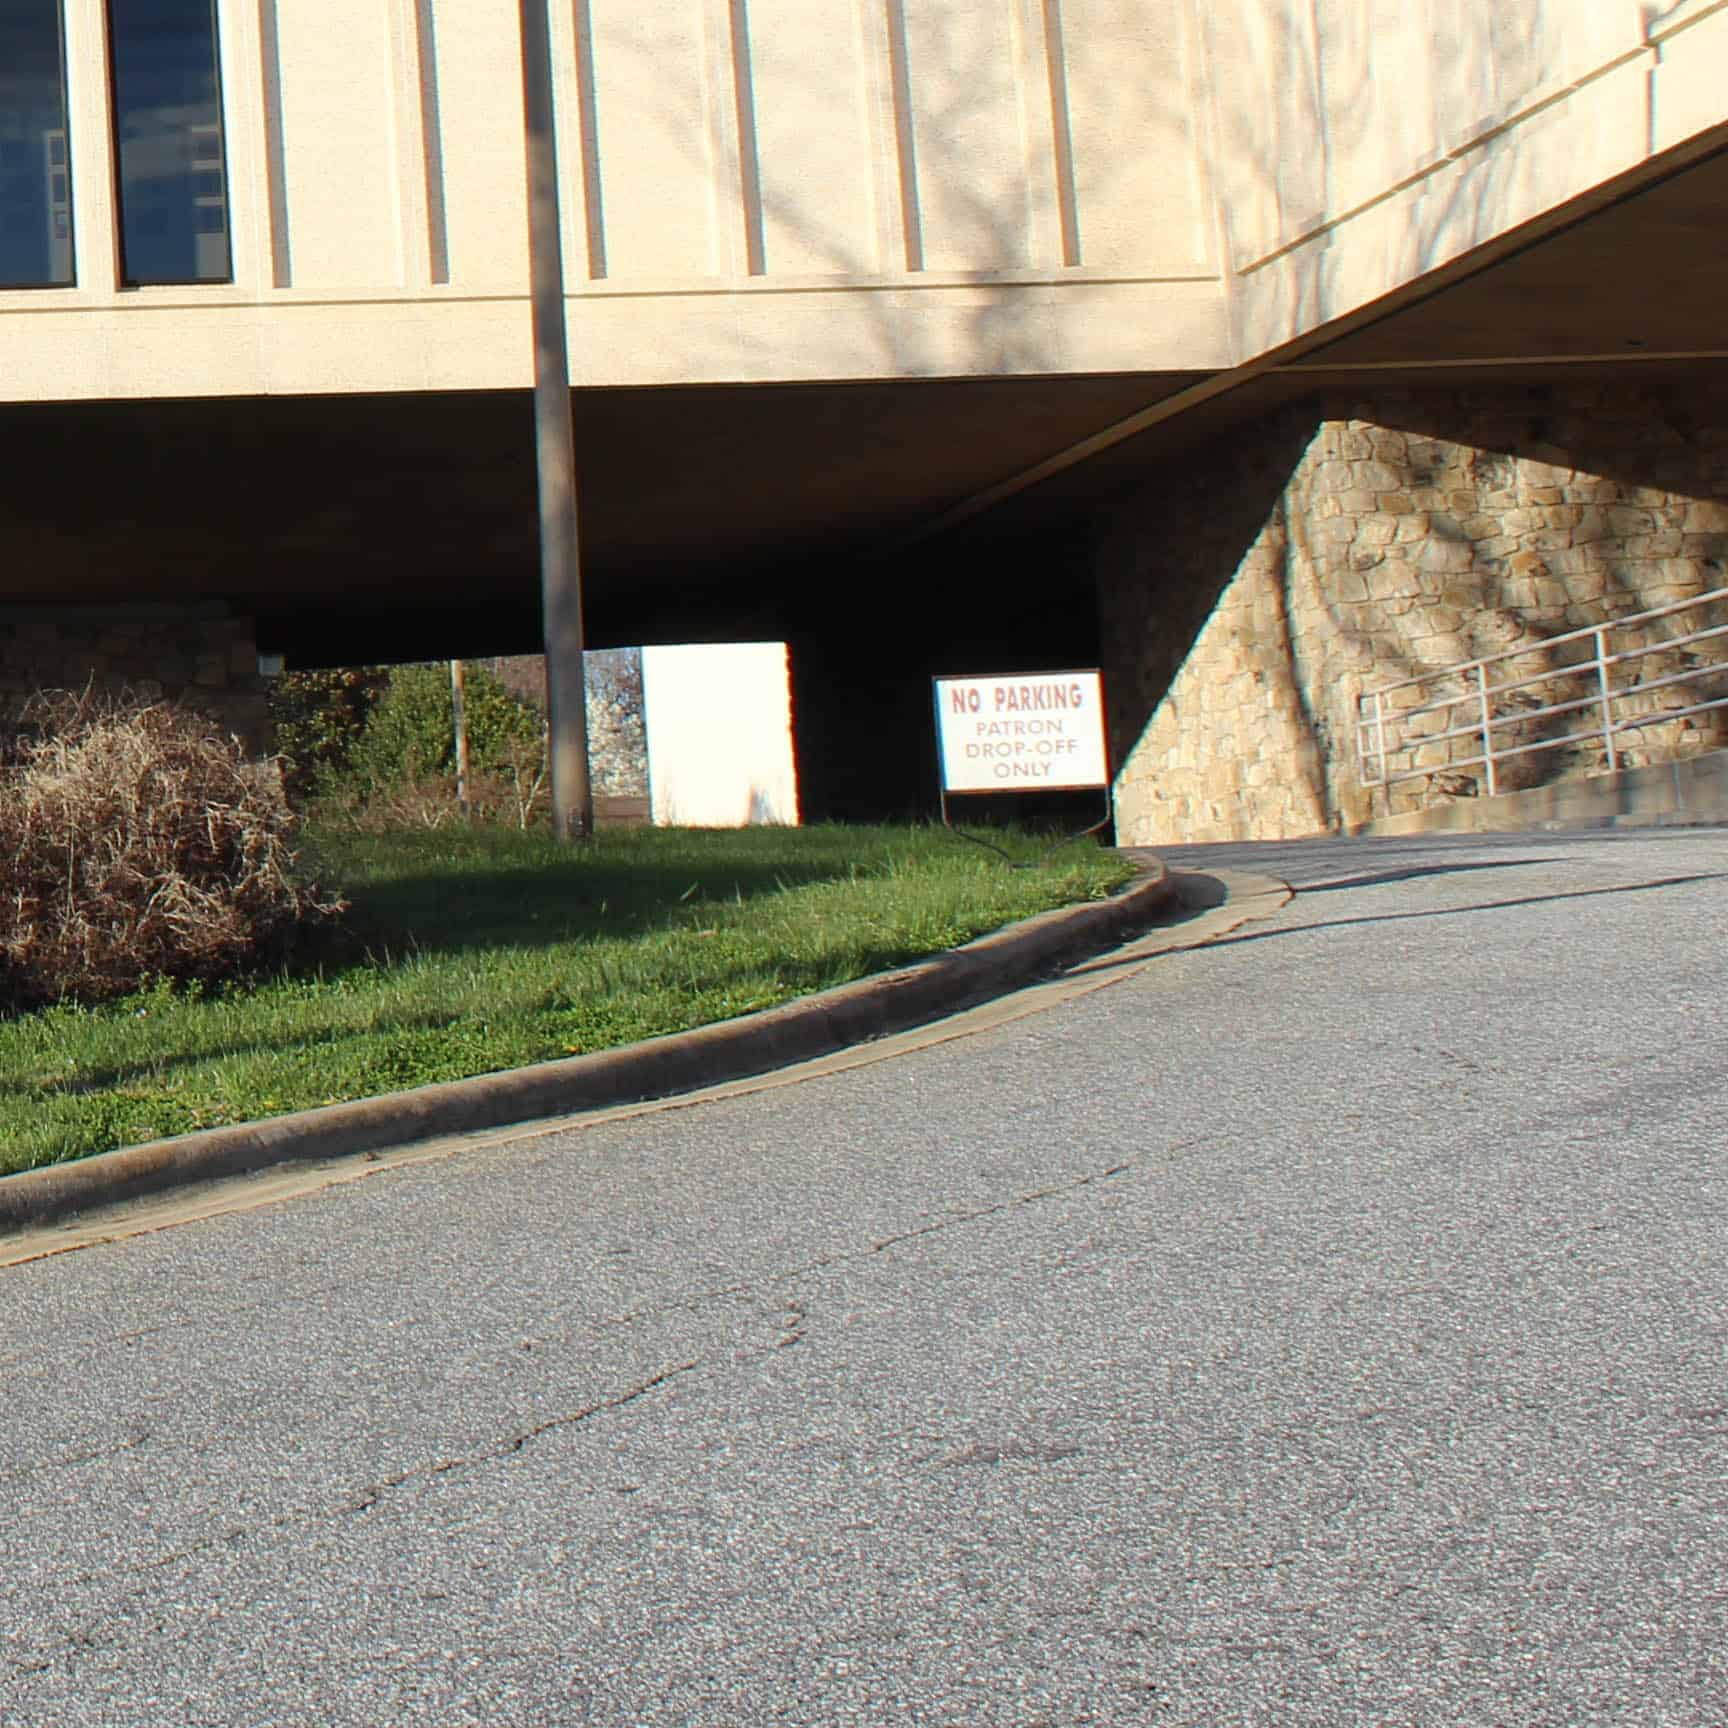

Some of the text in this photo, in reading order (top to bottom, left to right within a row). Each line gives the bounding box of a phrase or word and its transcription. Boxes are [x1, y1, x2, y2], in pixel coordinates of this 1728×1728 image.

[951, 683, 1083, 714] NO PARKING
[976, 719, 1063, 736] PATRON
[965, 739, 1080, 758] DROP-OFF
[993, 762, 1052, 779] ONLY
